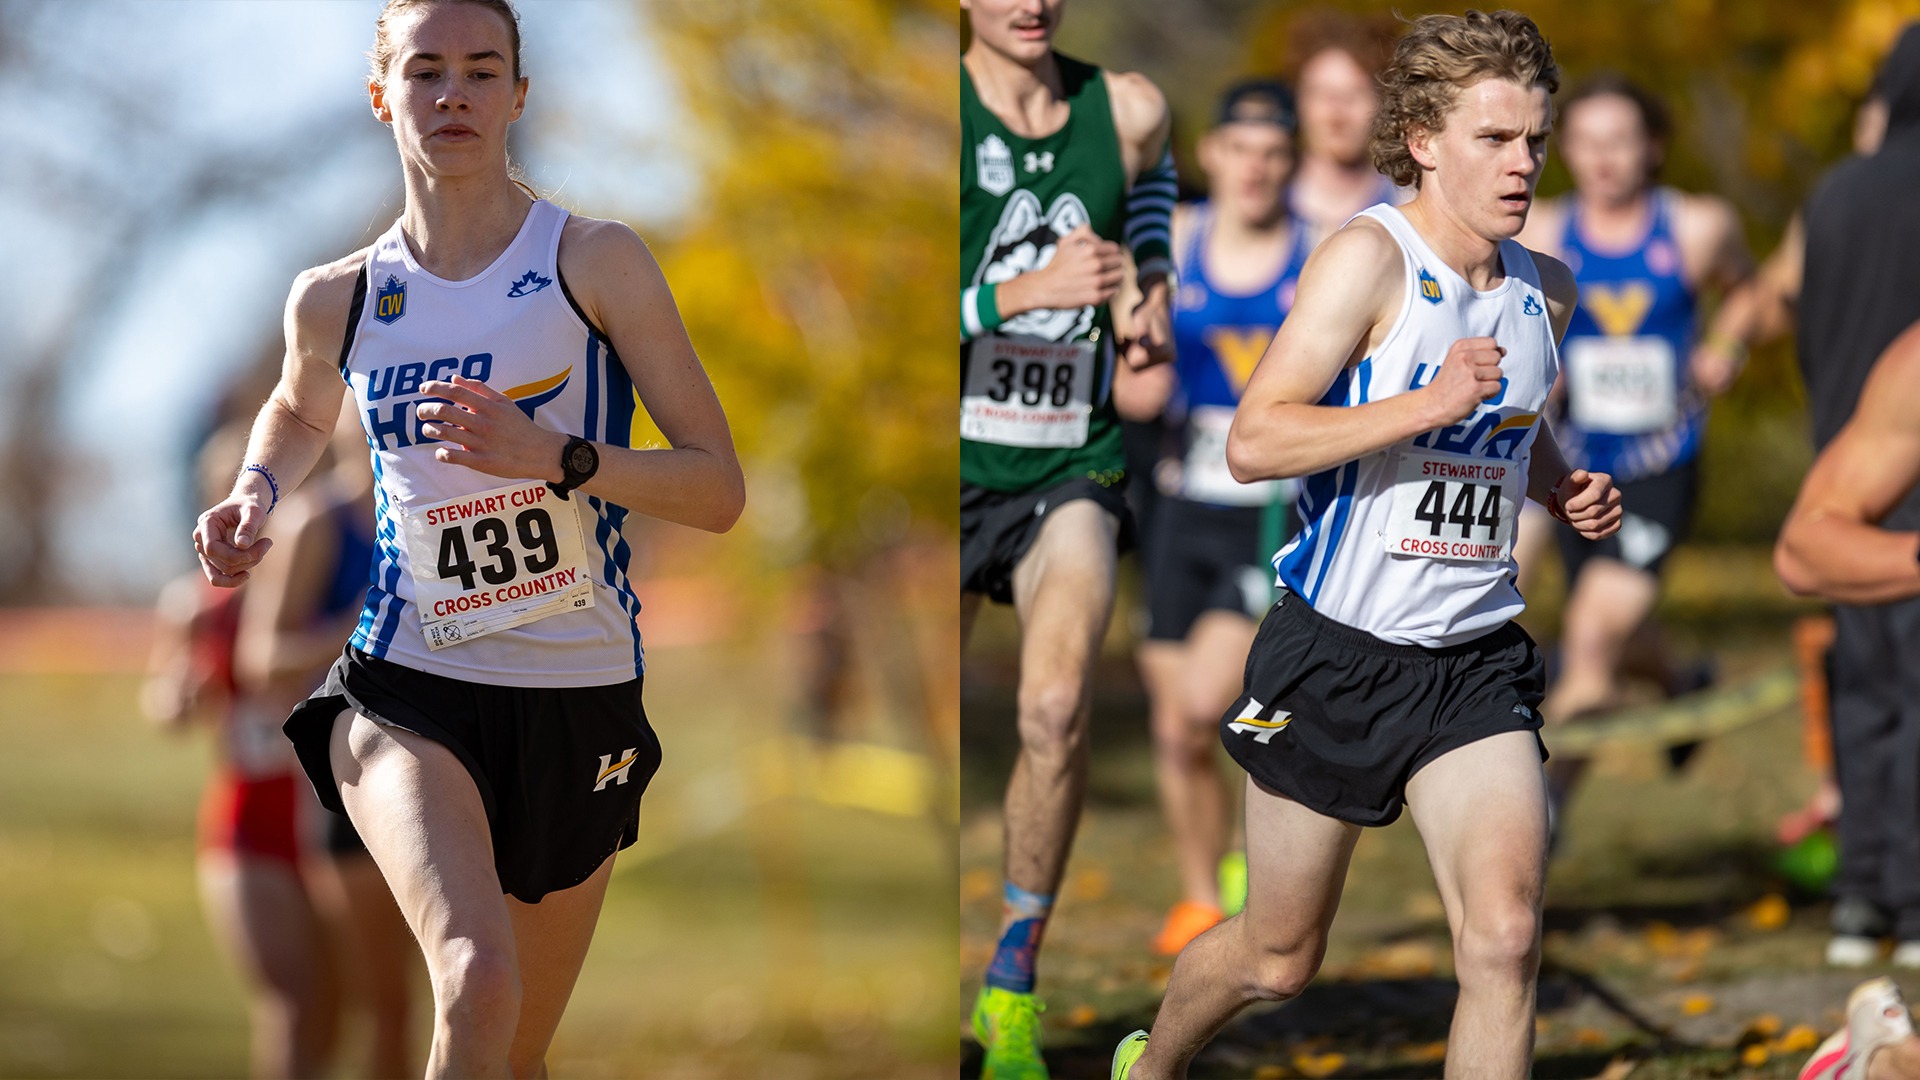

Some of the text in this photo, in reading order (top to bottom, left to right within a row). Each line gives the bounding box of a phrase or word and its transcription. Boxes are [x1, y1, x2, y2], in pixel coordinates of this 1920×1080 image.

[367, 352, 493, 402] UBCO
[988, 359, 1074, 407] 398
[1422, 461, 1506, 480] STEWART CUP
[427, 486, 546, 526] STEWART CUP
[1414, 479, 1502, 540] 444
[437, 508, 560, 591] 439
[1400, 538, 1503, 559] CROSS COUNTRY
[433, 567, 577, 617] CROSS COUNTRY
[573, 599, 586, 608] 439
